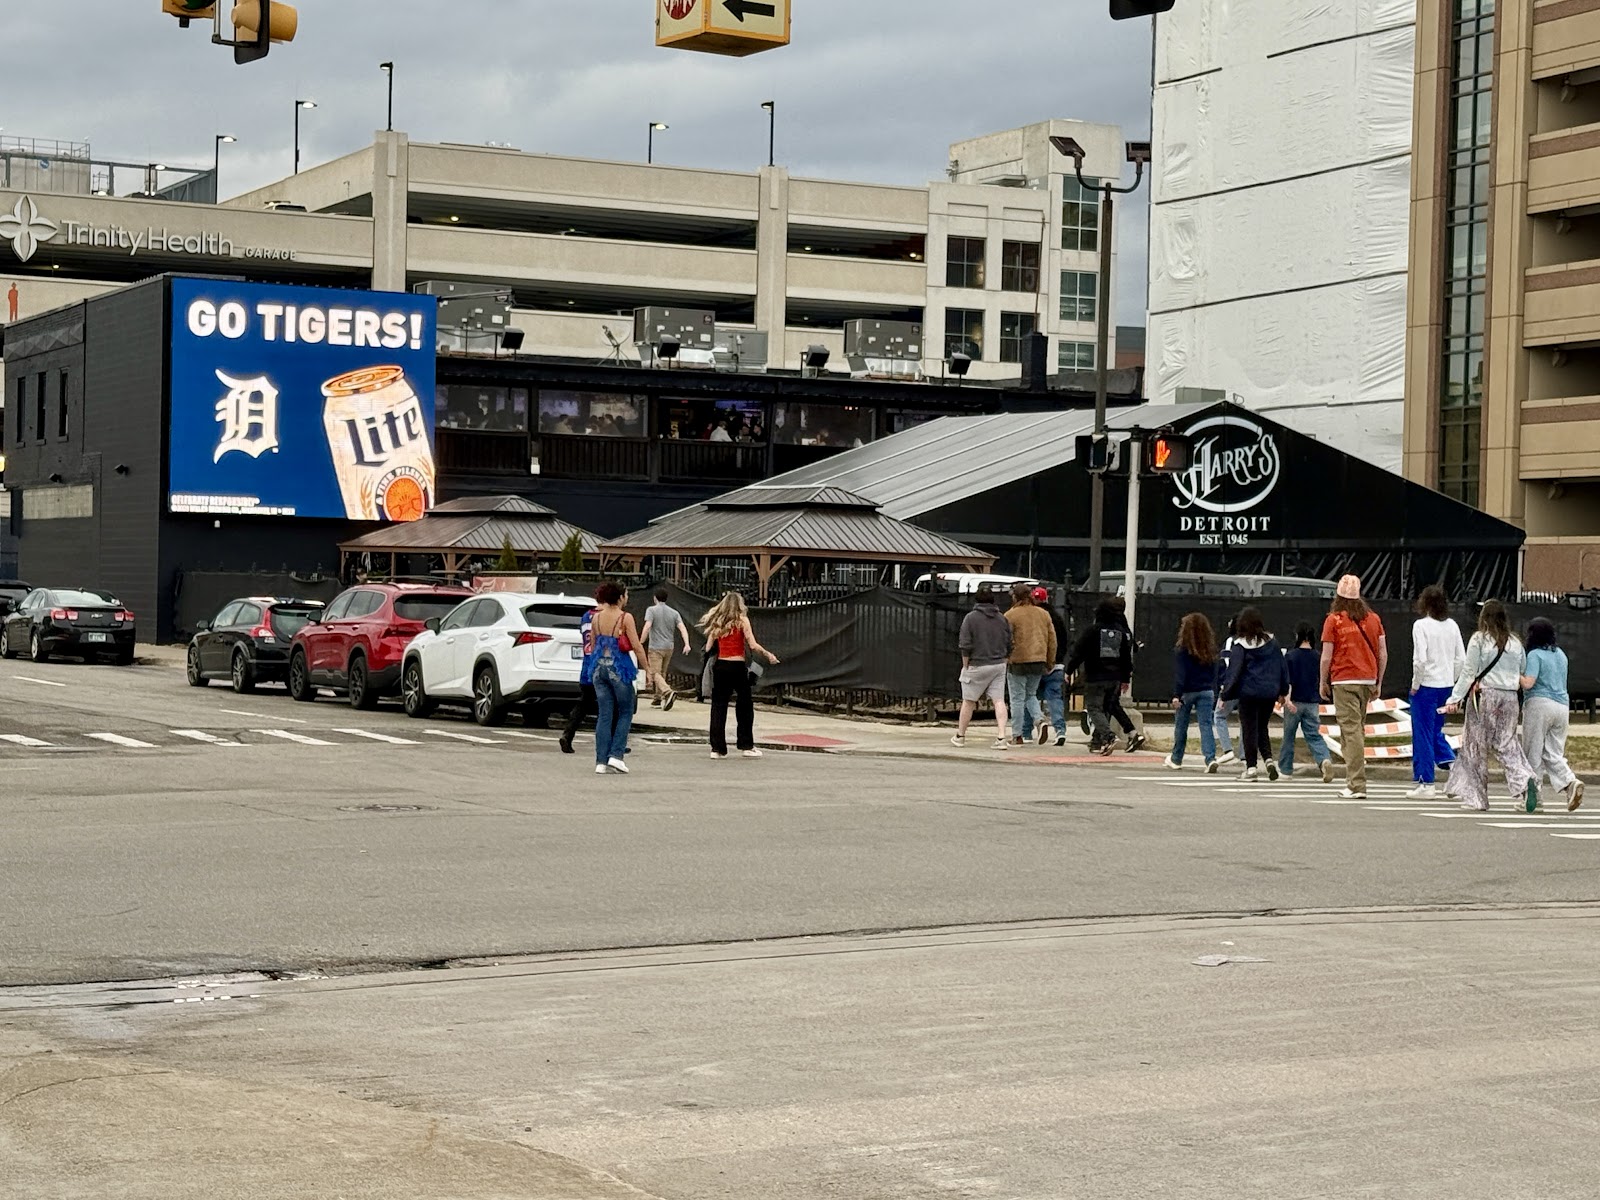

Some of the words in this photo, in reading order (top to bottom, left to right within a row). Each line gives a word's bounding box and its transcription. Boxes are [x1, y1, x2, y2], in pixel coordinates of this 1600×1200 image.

[60, 219, 144, 255] Trinity
[147, 226, 233, 256] Health
[245, 246, 297, 261] GARAGE
[187, 300, 247, 339] GO
[256, 303, 422, 350] TIGERS!
[343, 406, 420, 467] Lite
[1172, 426, 1274, 509] HARRY'S
[1180, 516, 1271, 532] DETROIT
[1199, 534, 1224, 546] EST.
[1226, 534, 1249, 546] 1945
